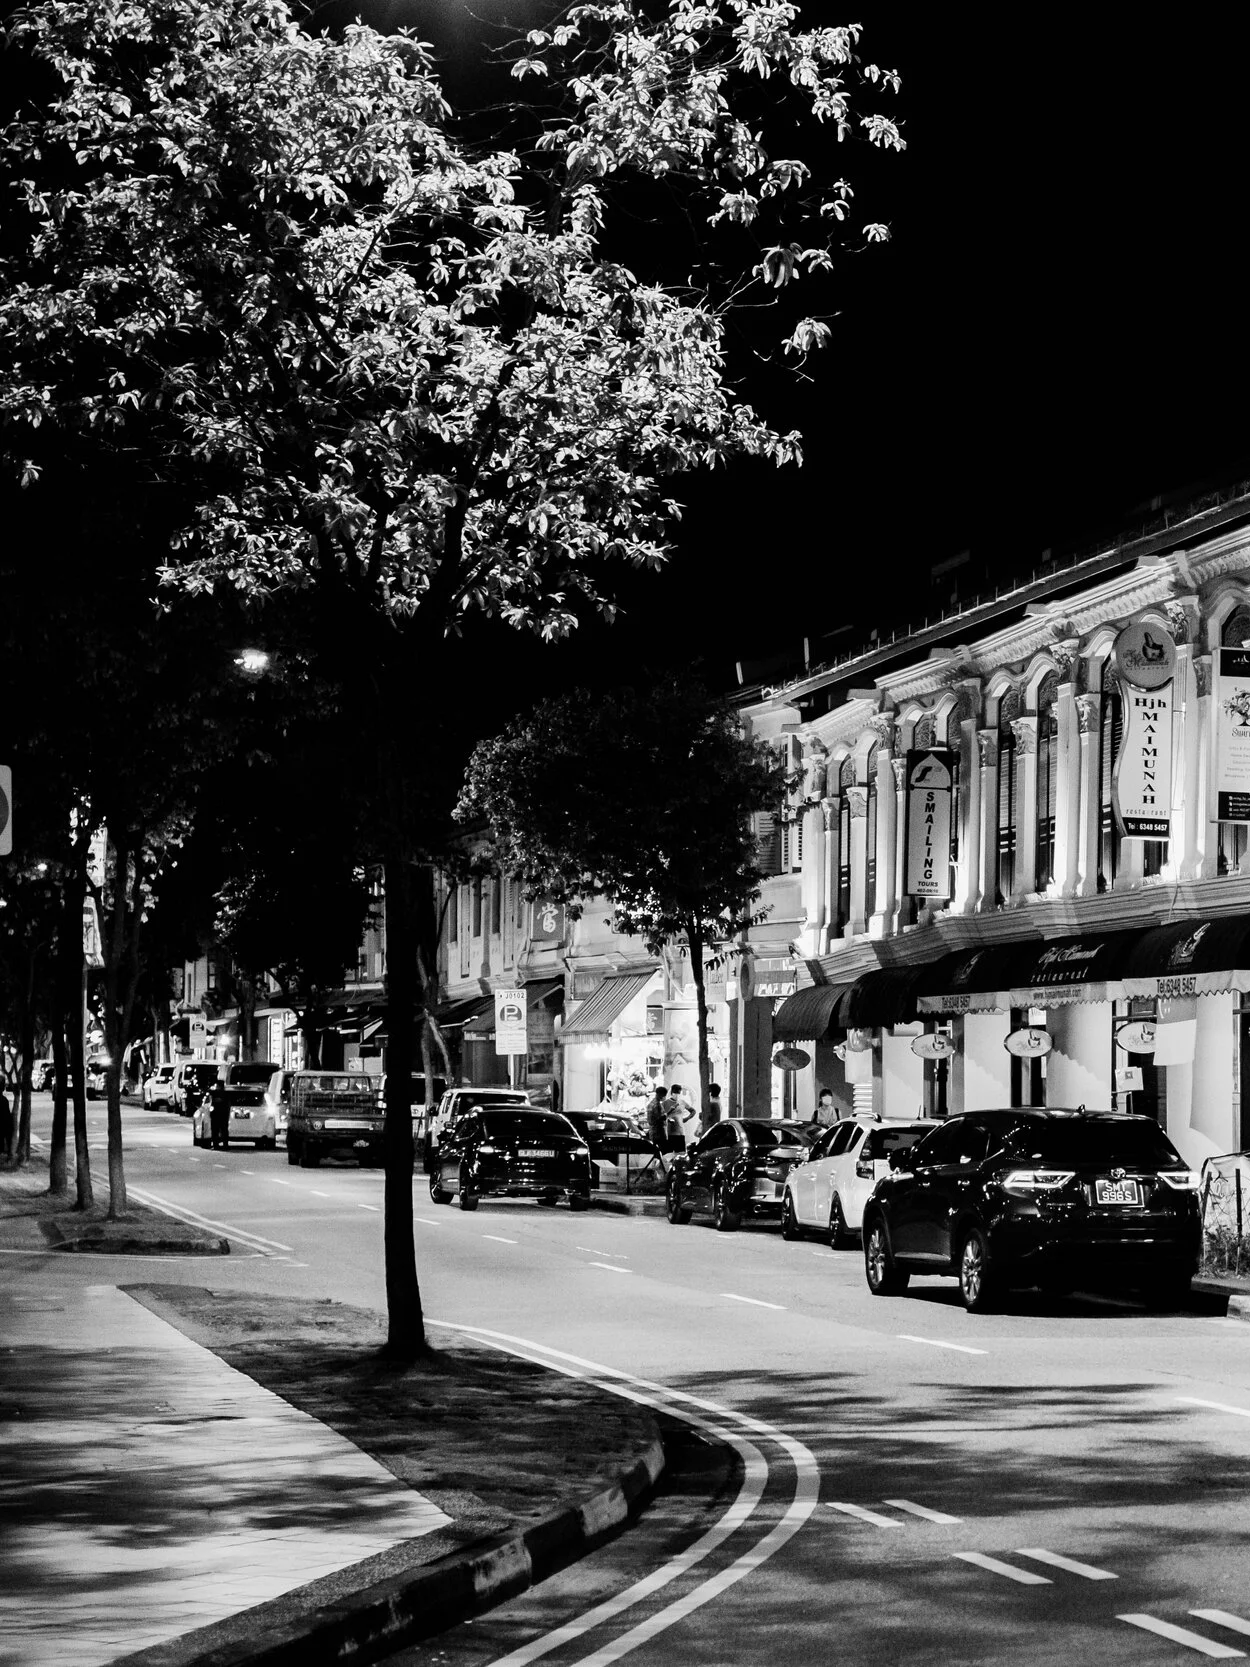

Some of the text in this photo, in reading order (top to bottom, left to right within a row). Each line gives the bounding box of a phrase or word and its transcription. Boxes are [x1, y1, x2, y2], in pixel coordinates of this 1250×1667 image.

[1134, 697, 1167, 710] Hjh
[1142, 712, 1158, 804] MAIMUNAH
[1126, 808, 1167, 816] restarant
[1140, 823, 1154, 831] 6348
[924, 791, 936, 880] SMAILING
[1182, 976, 1197, 993] 5457
[1102, 1191, 1133, 1201] 996S
